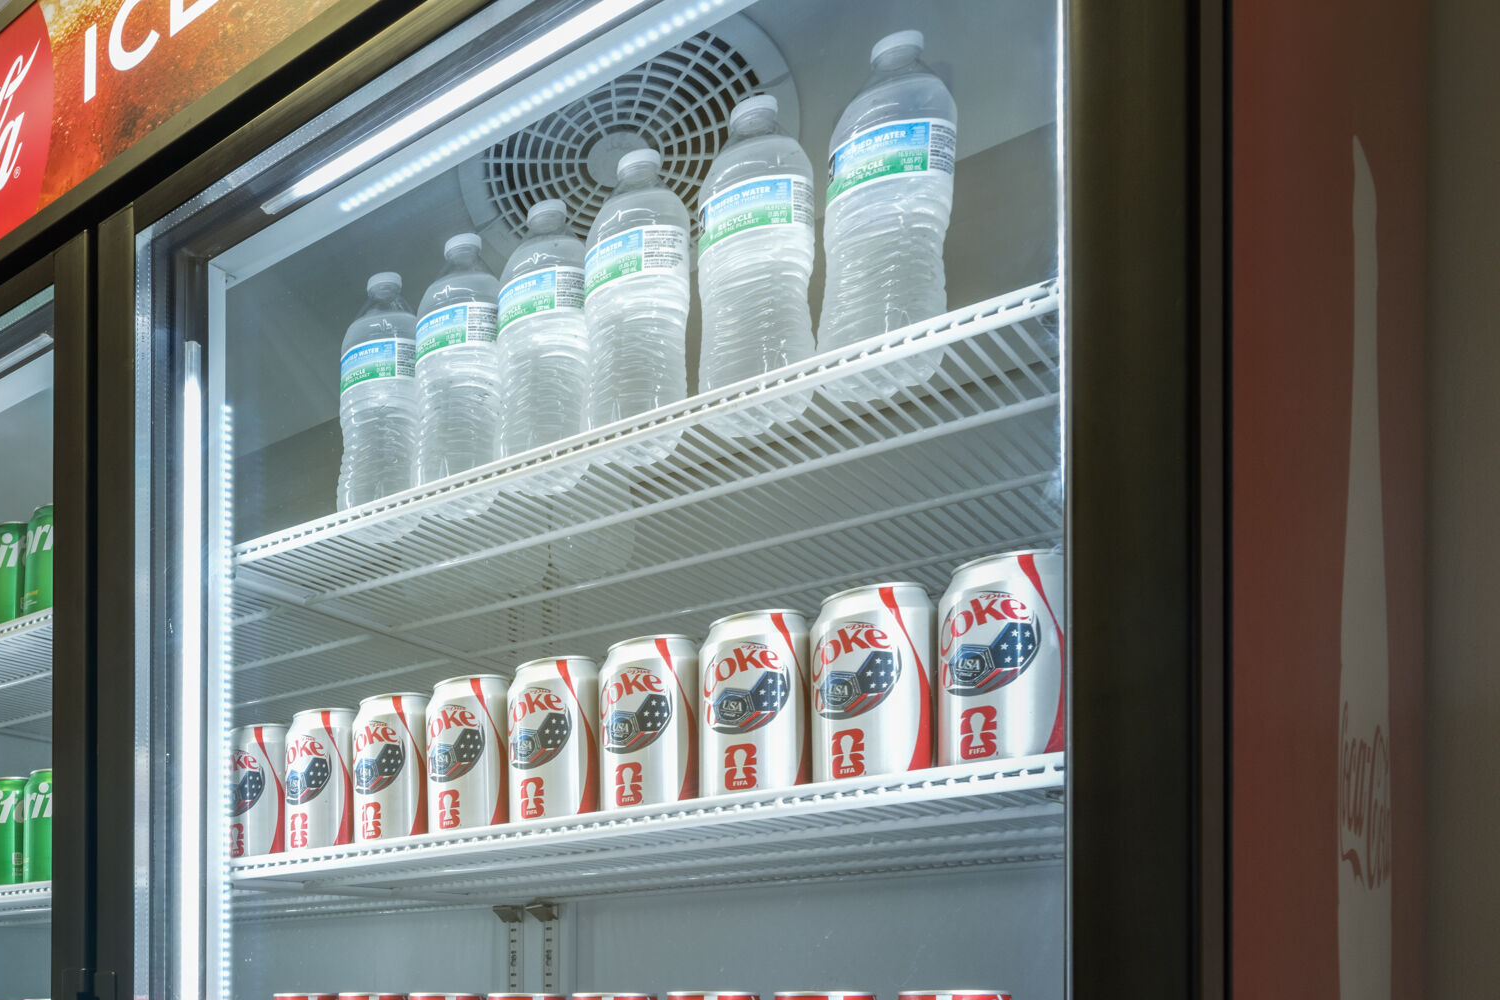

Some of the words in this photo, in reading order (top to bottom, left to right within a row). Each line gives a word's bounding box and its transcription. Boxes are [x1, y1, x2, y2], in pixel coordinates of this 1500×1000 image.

[874, 130, 907, 144] WATER
[741, 186, 771, 197] WATER
[718, 212, 753, 231] RECYCLE
[941, 597, 1031, 652] Coke
[957, 658, 981, 671] USA
[723, 699, 743, 712] USA
[969, 746, 987, 755] FIFA
[732, 780, 749, 788] FIFA
